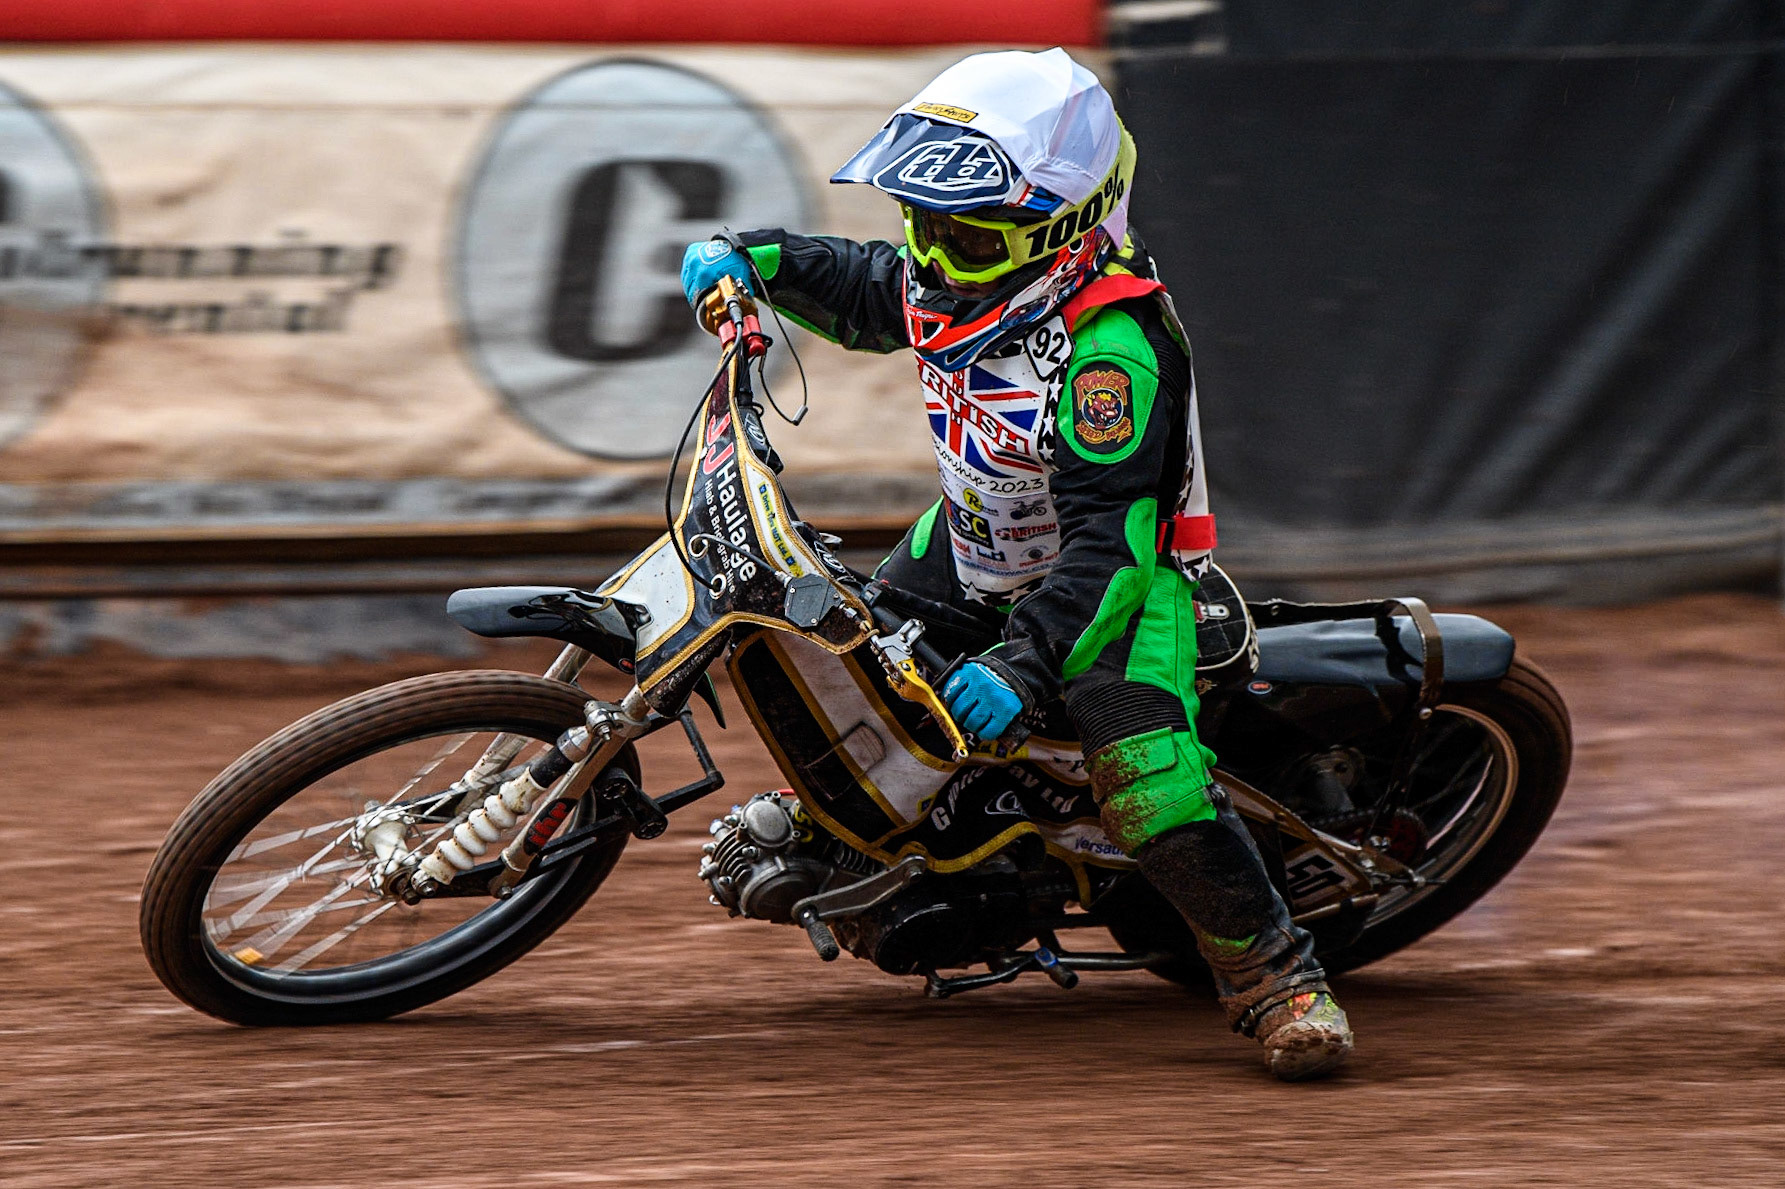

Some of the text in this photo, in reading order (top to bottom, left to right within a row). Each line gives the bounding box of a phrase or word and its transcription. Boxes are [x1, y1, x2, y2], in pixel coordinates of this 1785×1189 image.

[1025, 162, 1124, 259] 100%
[1033, 326, 1066, 365] 92
[919, 362, 1027, 454] RITISH
[704, 412, 735, 475] JJ
[704, 479, 715, 504] Hiab
[708, 505, 717, 516] &
[990, 478, 1044, 493] 2023
[711, 517, 730, 568] Bric-grab
[716, 459, 757, 582] Haulage
